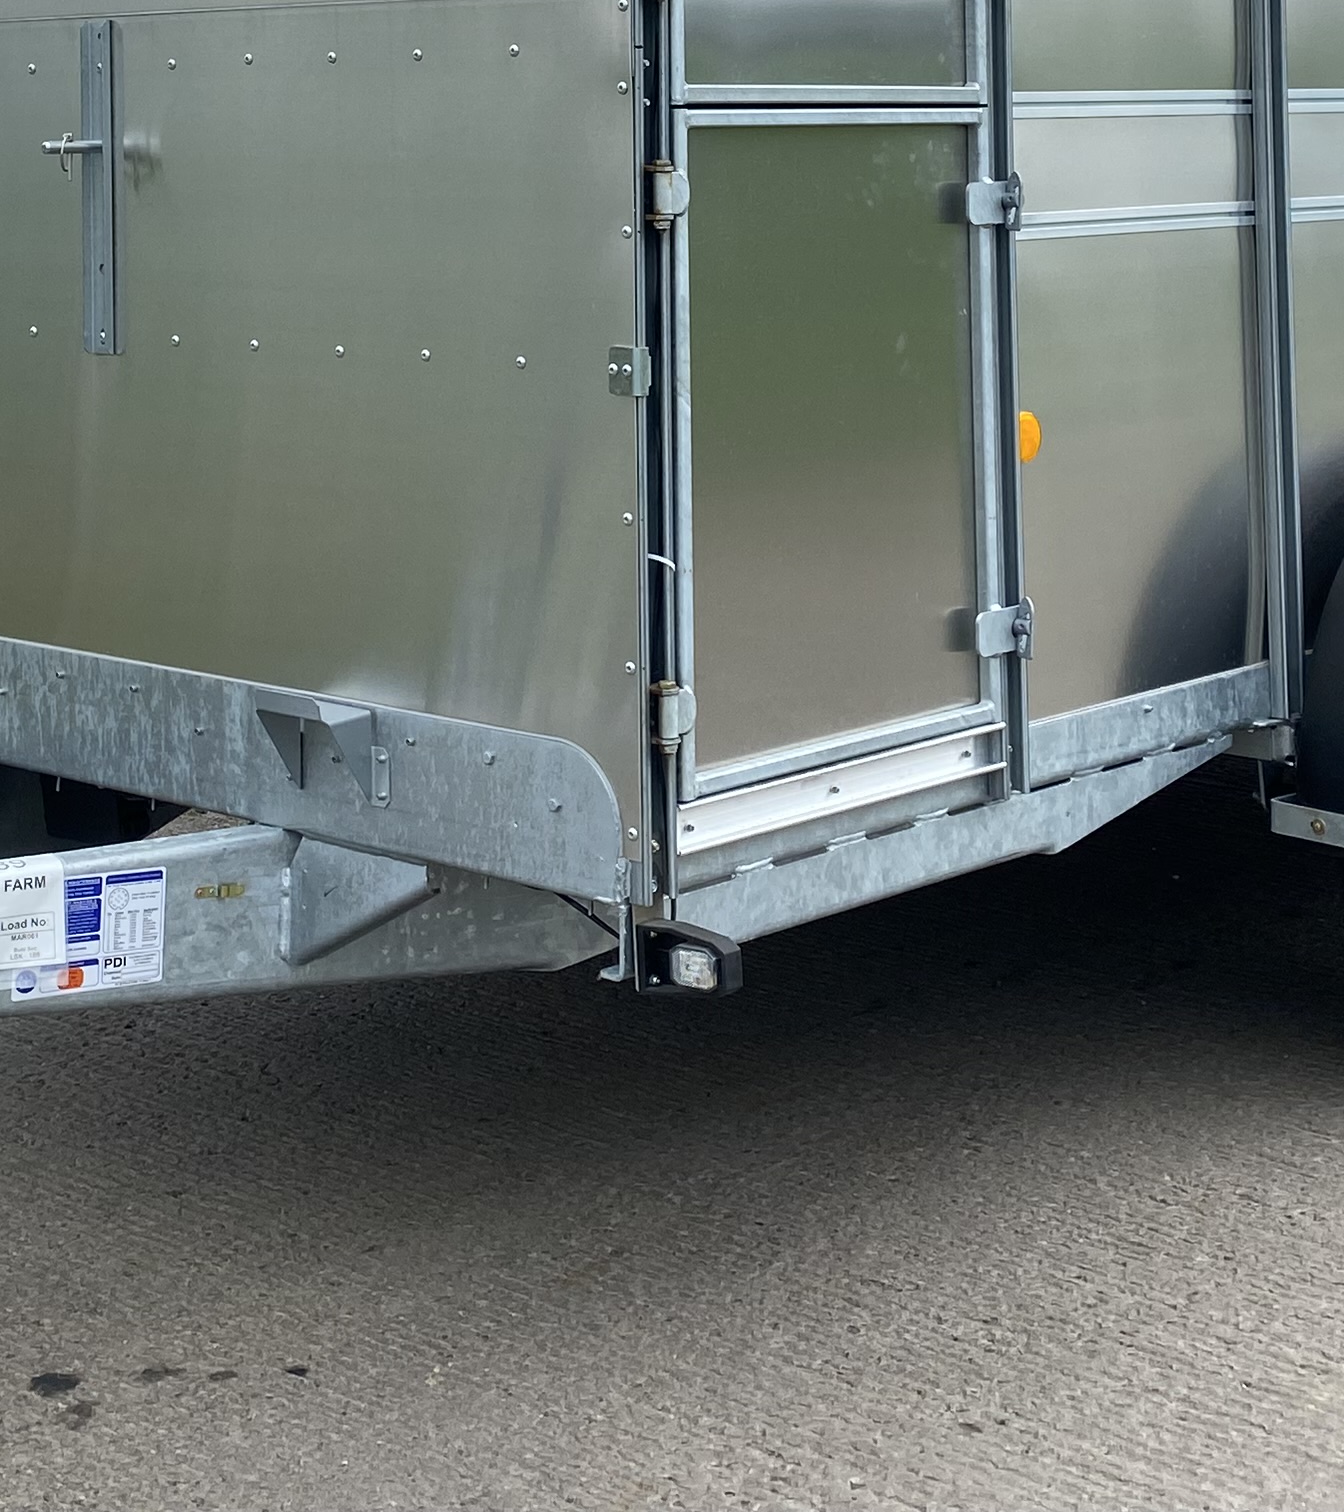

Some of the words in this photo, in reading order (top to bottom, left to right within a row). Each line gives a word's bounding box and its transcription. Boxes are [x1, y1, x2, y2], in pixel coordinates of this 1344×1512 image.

[4, 875, 46, 893] FARM
[0, 918, 28, 931] Load
[104, 956, 127, 969] PDI
